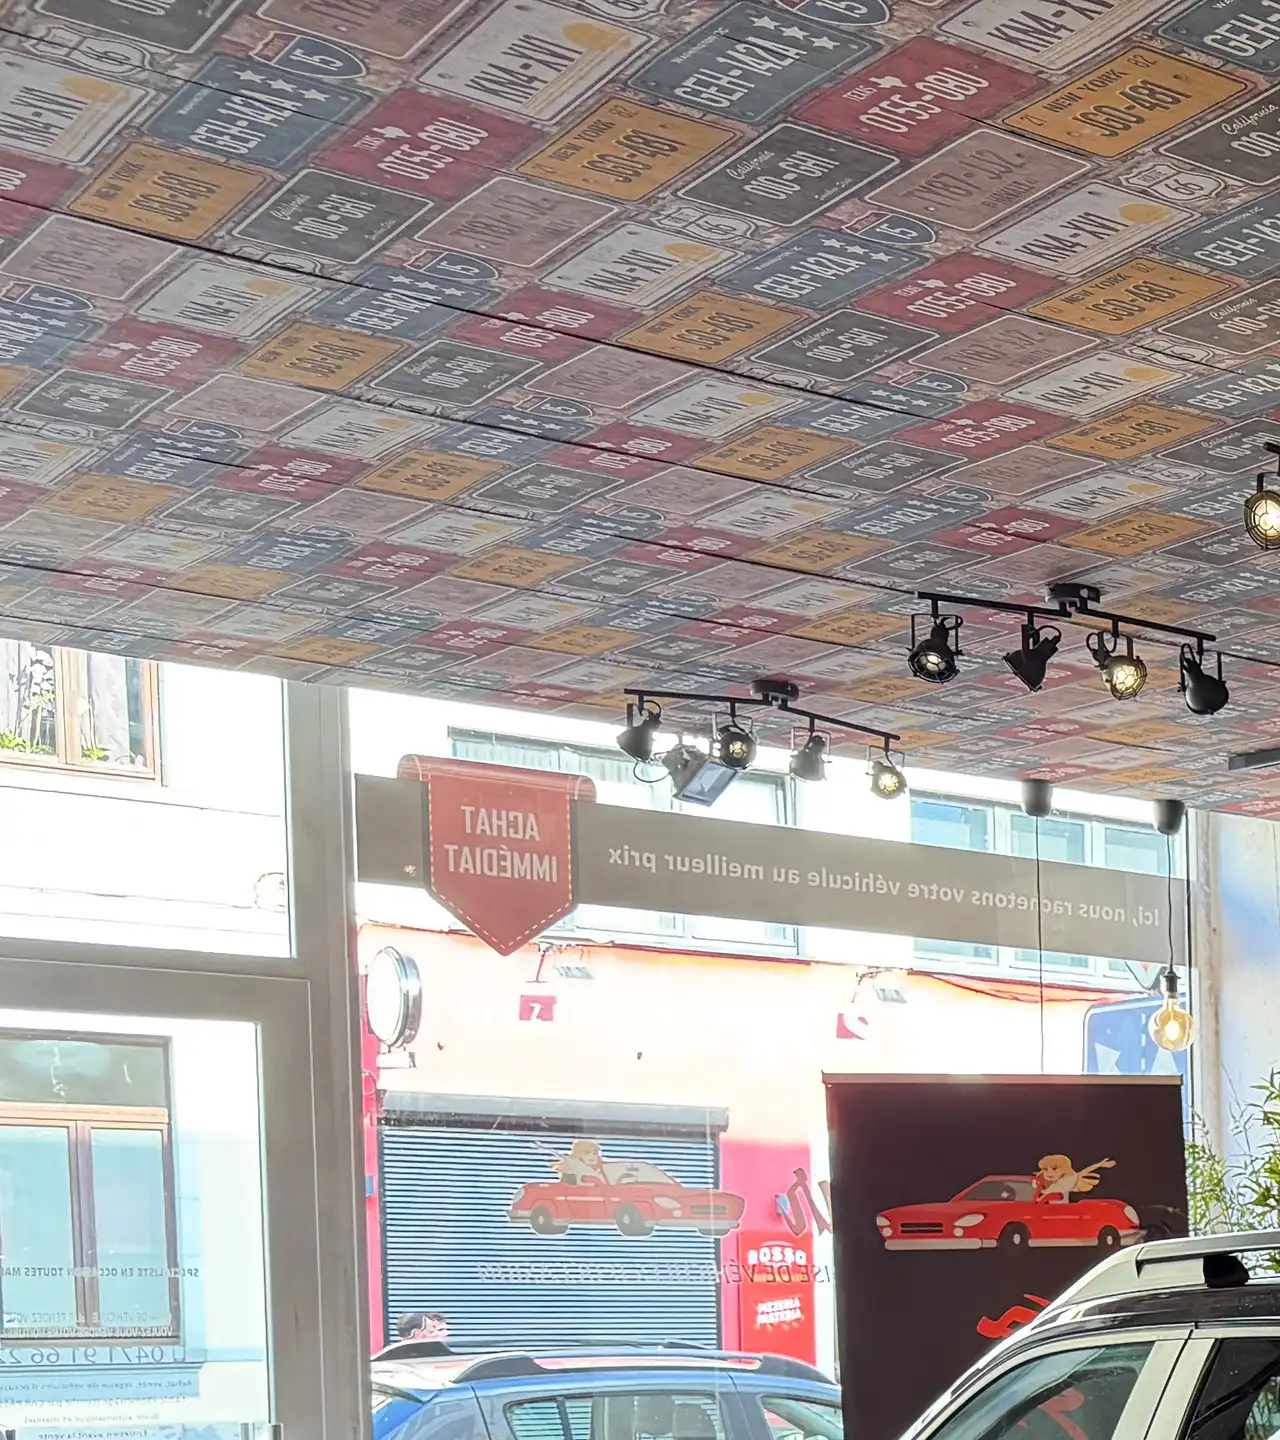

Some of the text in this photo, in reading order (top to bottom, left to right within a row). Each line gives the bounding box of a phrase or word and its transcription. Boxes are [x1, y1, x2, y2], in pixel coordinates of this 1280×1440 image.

[674, 36, 807, 108] GEH-142A
[1042, 89, 1077, 113] NEW
[1077, 69, 1128, 97] YORK
[1222, 103, 1278, 135] California
[1164, 178, 1206, 197] 66
[875, 216, 920, 242] 15
[752, 253, 867, 300] GEH-142A
[1062, 289, 1094, 305] NEW
